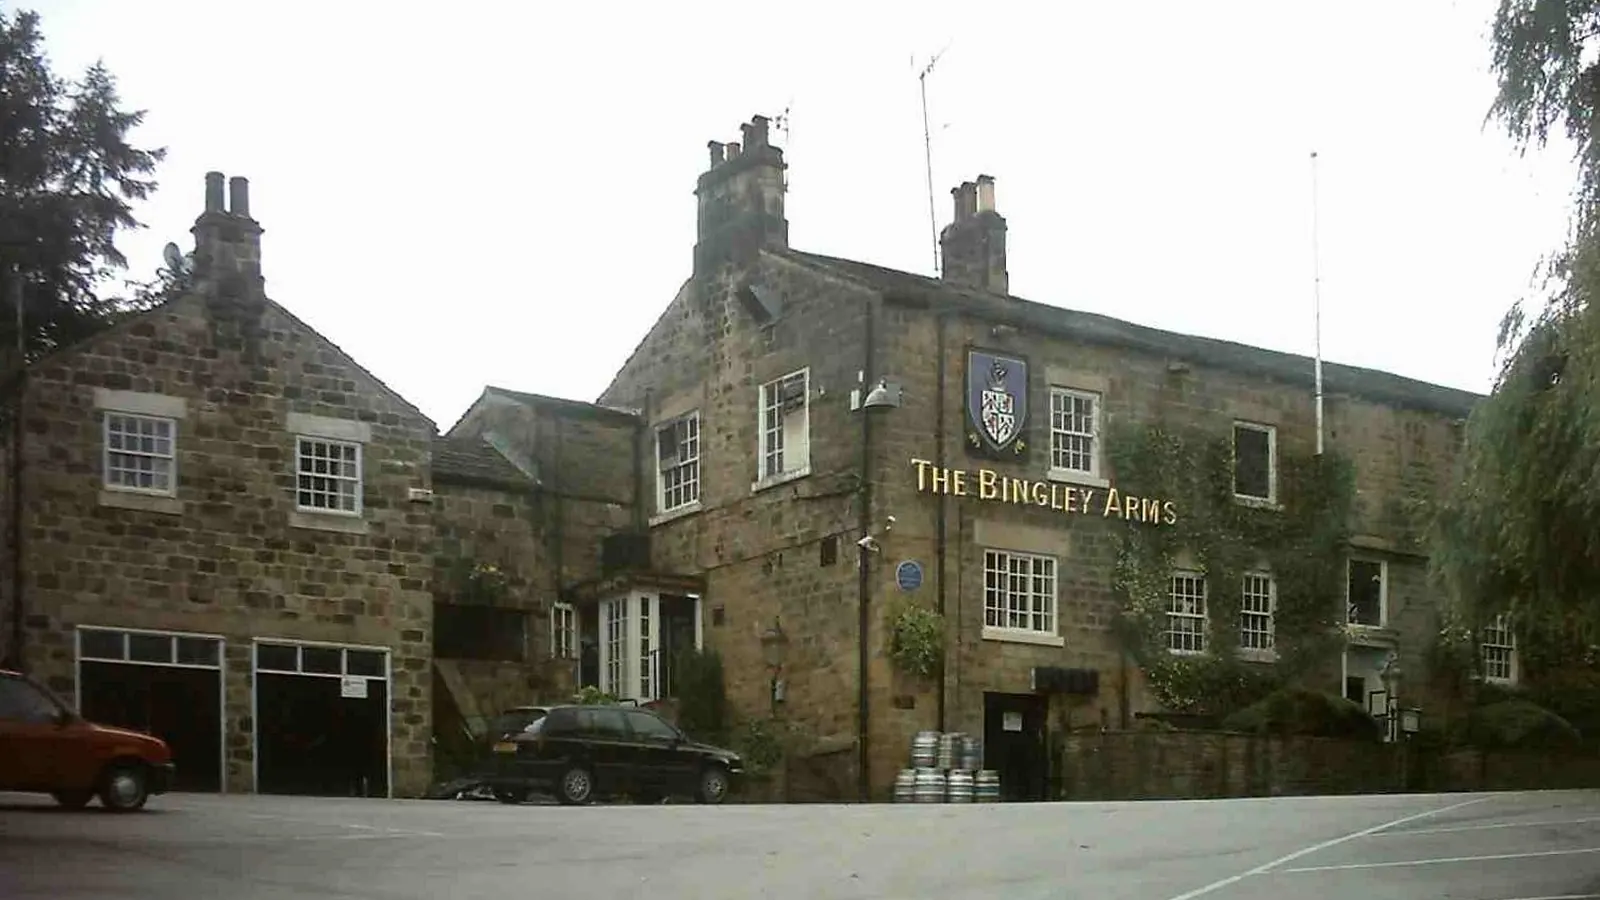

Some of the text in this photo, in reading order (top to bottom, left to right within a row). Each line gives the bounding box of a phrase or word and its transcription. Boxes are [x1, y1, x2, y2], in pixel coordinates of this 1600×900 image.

[911, 458, 1177, 525] THE BINGLEY ARMS
